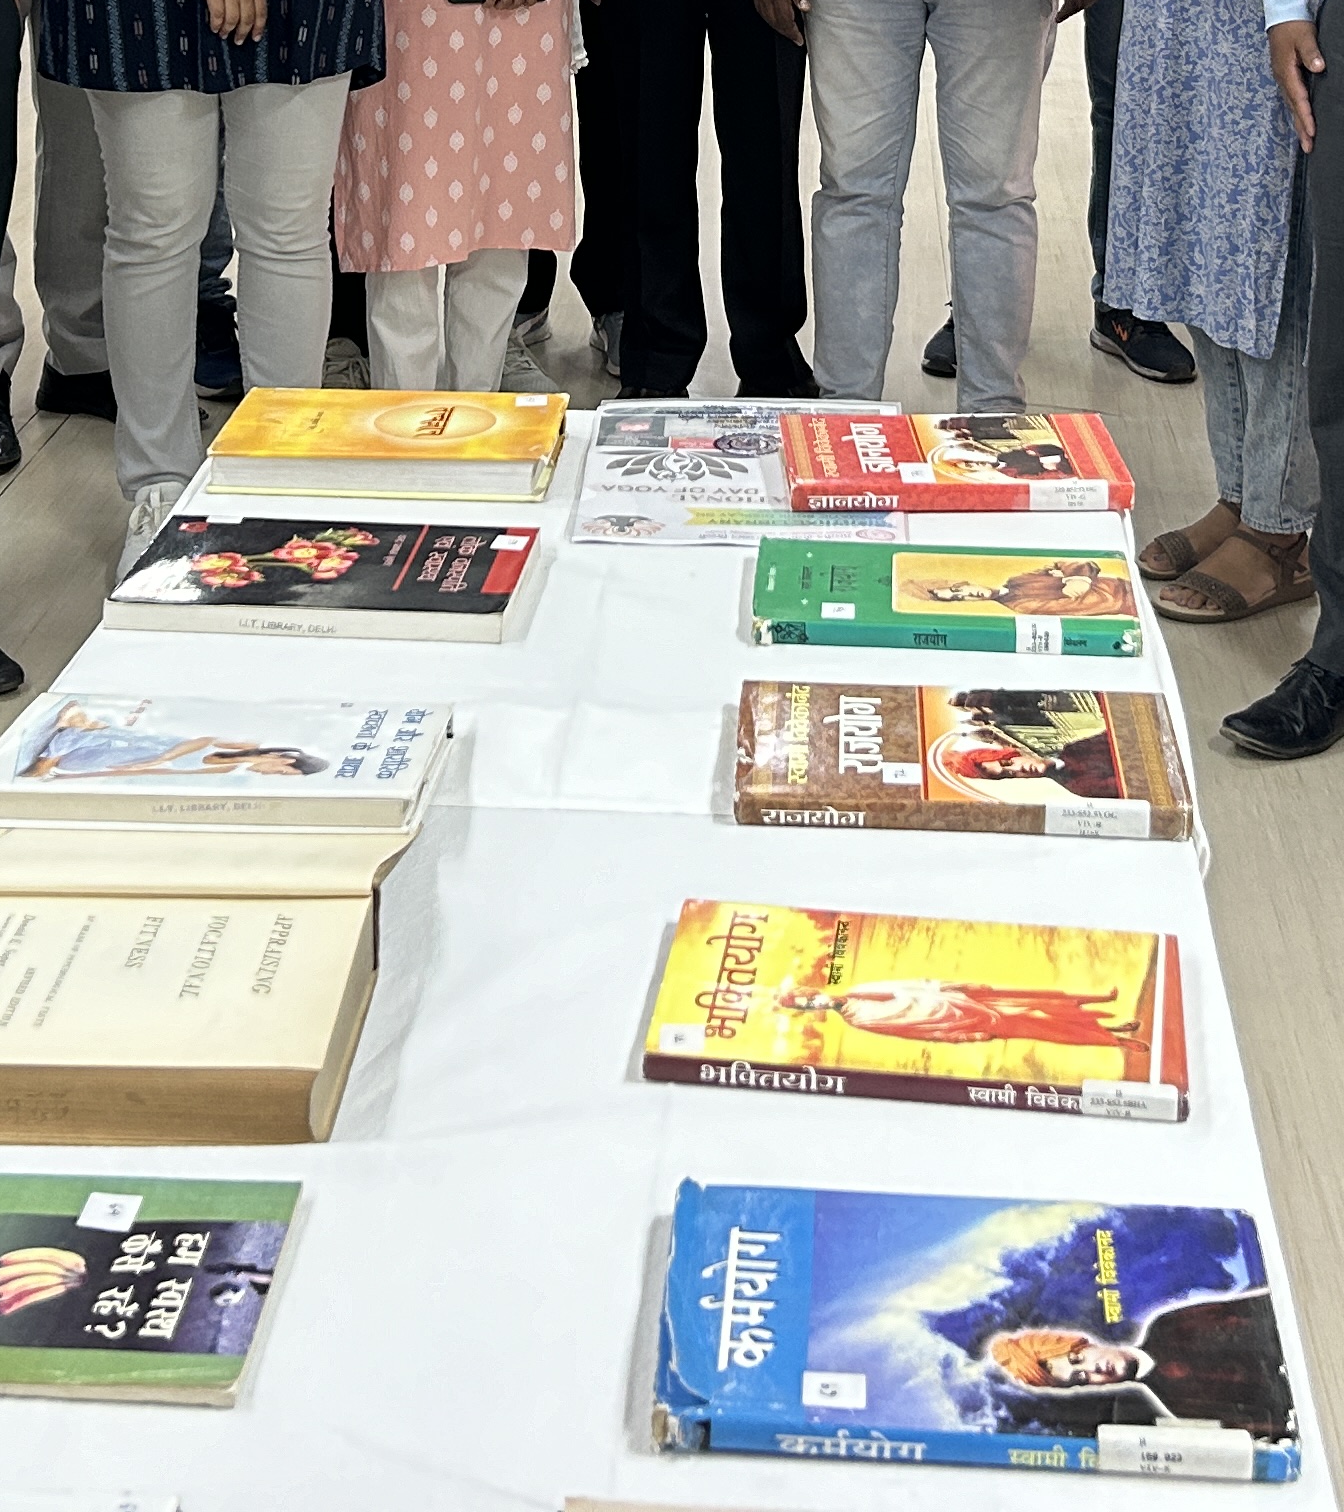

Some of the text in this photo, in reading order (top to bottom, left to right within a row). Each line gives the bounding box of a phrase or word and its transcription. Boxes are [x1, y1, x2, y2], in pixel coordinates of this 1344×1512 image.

[841, 422, 899, 474] ज्ञानयोग
[601, 484, 668, 493] YOGA
[807, 491, 899, 509] ज्ञानयोग
[912, 629, 948, 648] राजयोग
[823, 694, 884, 775] राजयोग
[760, 805, 867, 827] राजयोग
[124, 915, 165, 969] FITNESS
[178, 915, 230, 999] VOCATIONAL
[251, 913, 294, 996] APPRAISING
[695, 910, 769, 1039] भक्तियोग
[699, 1060, 847, 1094] भक्तियोग
[967, 1083, 1017, 1105] स्वामी
[1025, 1085, 1082, 1110] विवेका
[84, 1231, 163, 1339] कैसे रहें?
[138, 1231, 210, 1339] हम स्वस्थ
[699, 1225, 783, 1373] कर्मयोग
[1096, 1287, 1123, 1325] स्वामी
[775, 1428, 927, 1460] कर्मयोग
[1007, 1444, 1068, 1468] स्वामी
